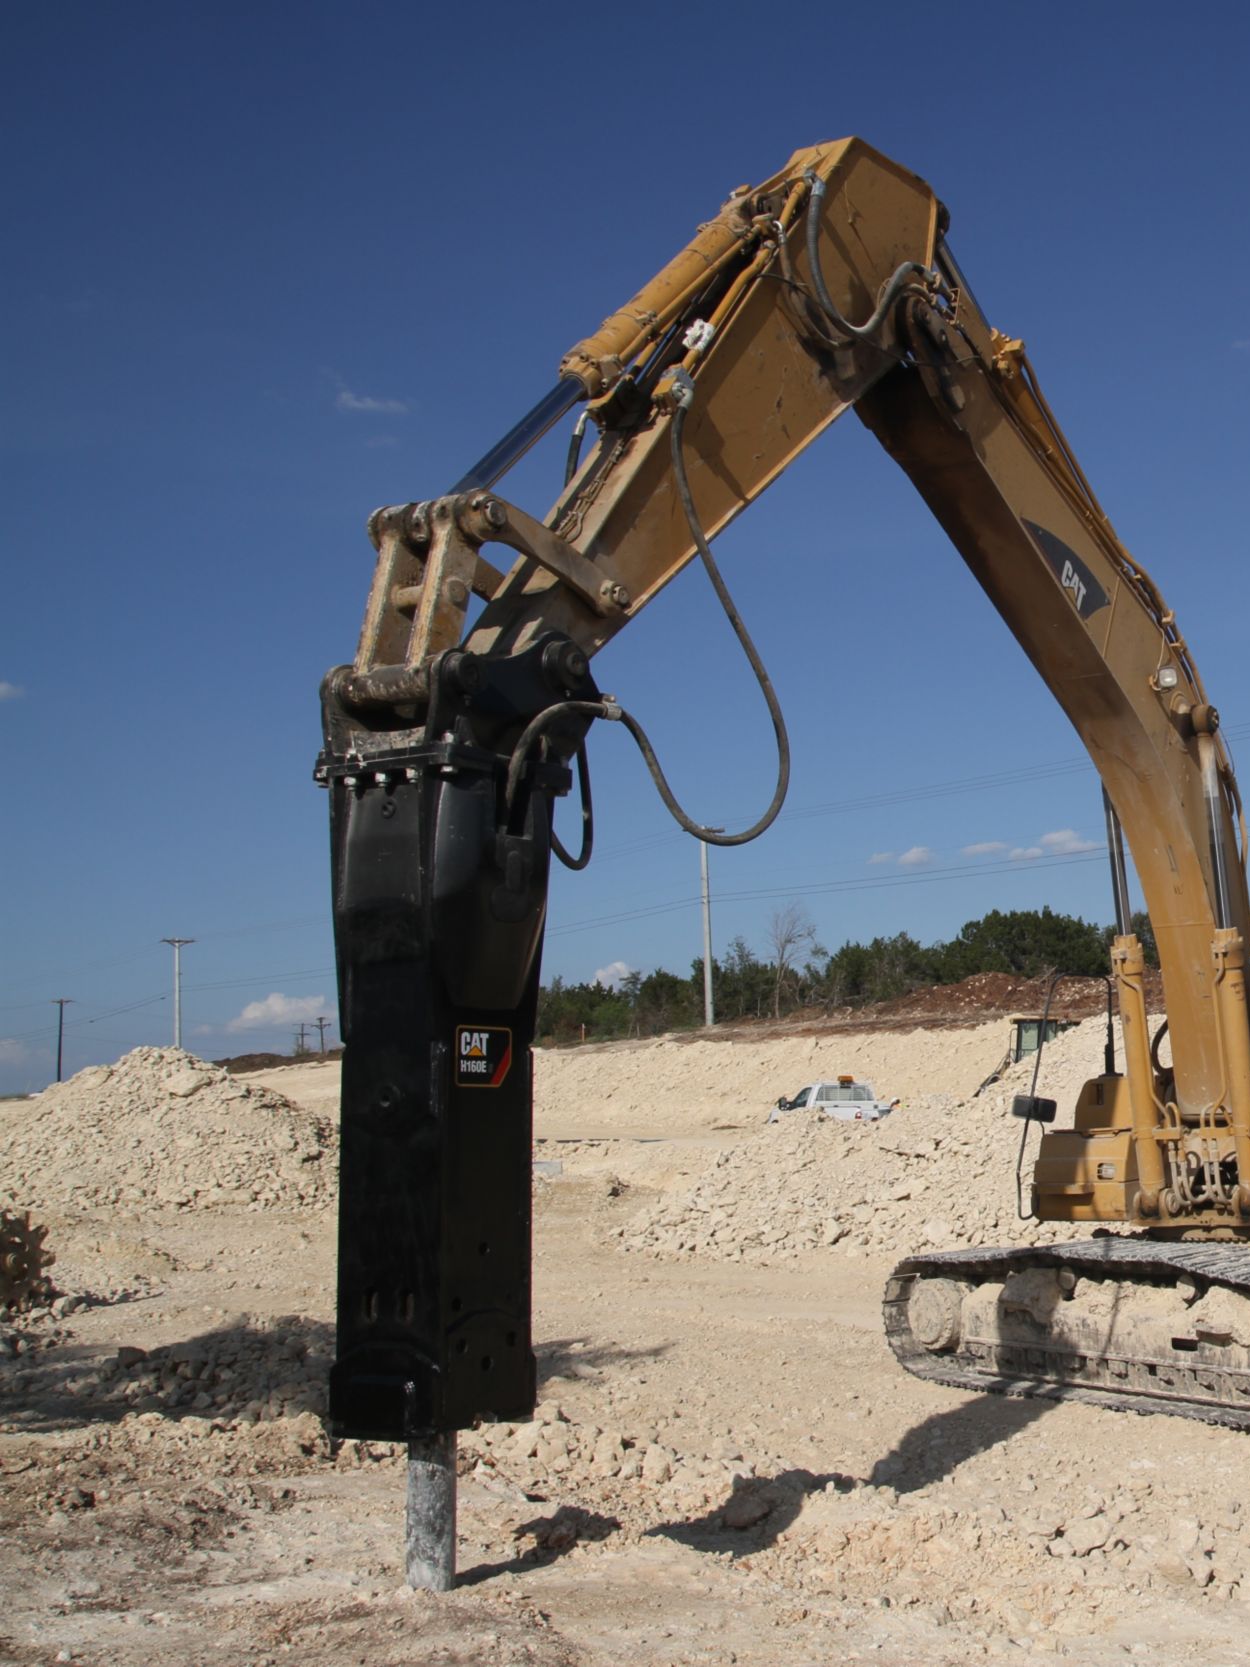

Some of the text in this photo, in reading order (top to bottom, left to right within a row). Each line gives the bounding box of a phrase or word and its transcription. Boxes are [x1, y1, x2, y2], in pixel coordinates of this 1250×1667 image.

[1061, 560, 1087, 611] CAT
[461, 1032, 489, 1056] CAT
[460, 1060, 487, 1073] H160E
